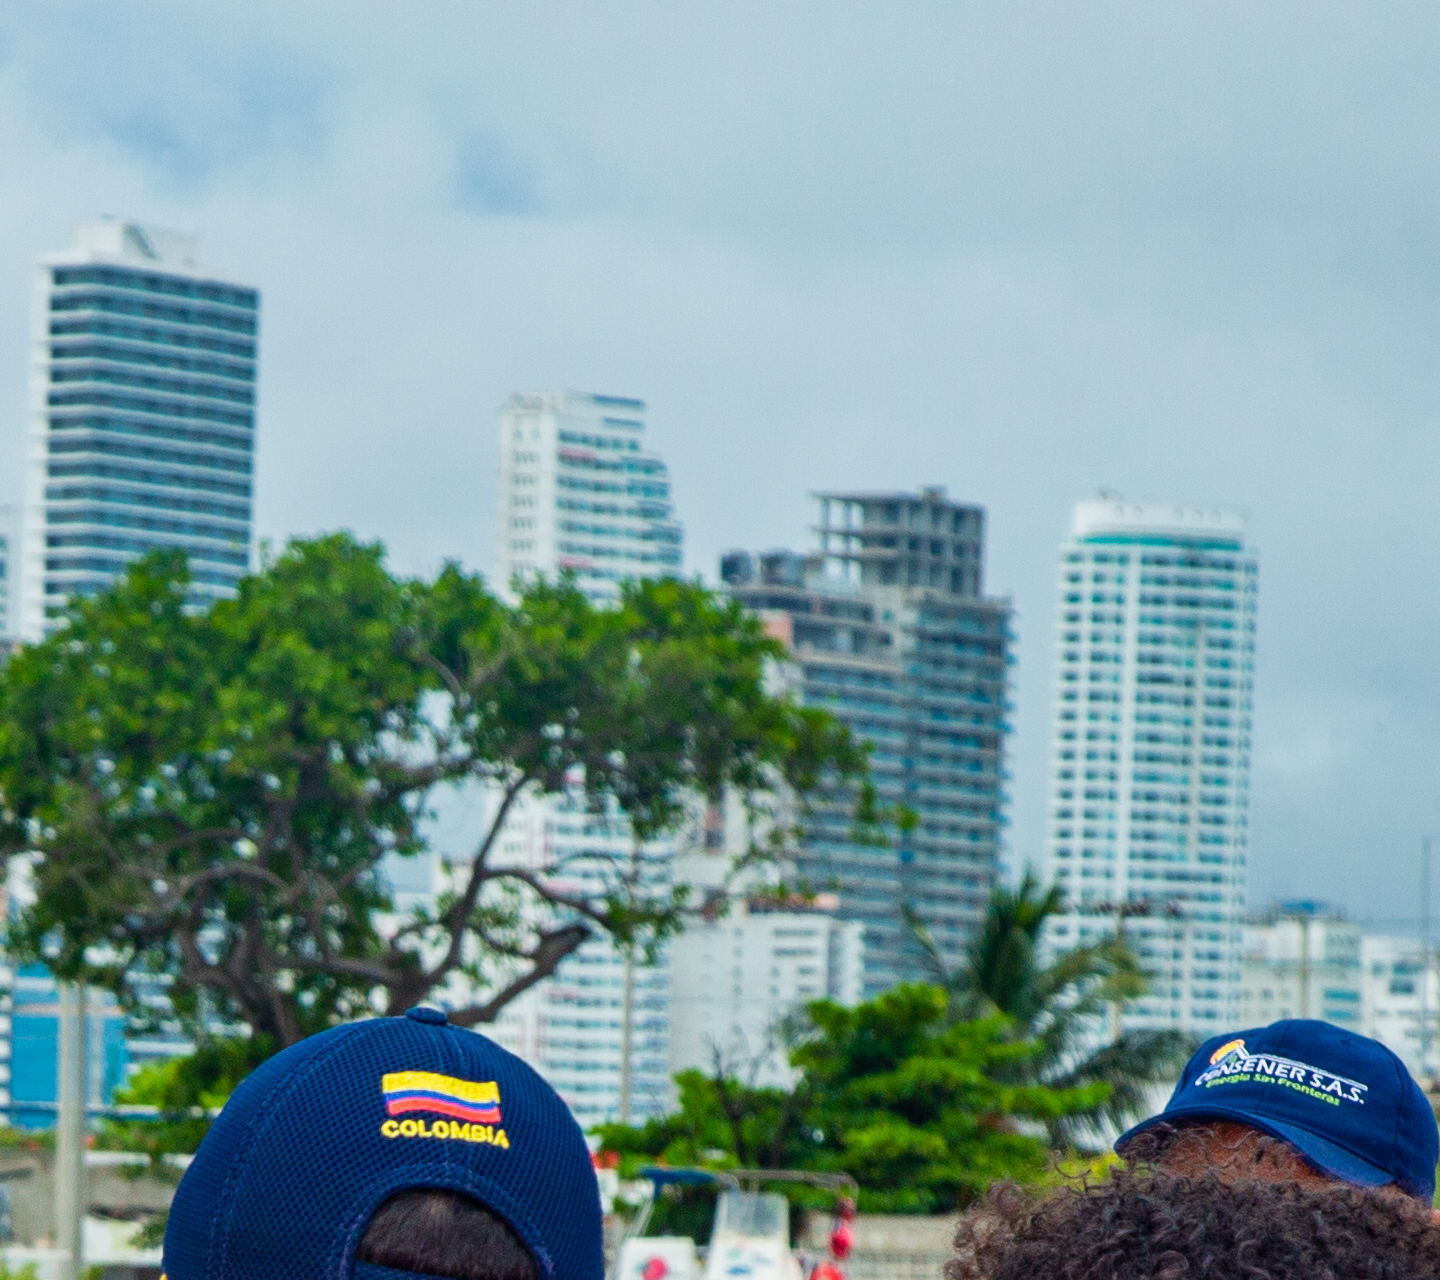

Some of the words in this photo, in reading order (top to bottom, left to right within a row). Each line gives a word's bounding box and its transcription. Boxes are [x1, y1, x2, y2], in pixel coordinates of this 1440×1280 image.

[1195, 1056, 1306, 1087] CONSENER
[1309, 1072, 1365, 1105] S.A.S.
[1252, 1073, 1276, 1084] Sin
[380, 1119, 511, 1150] COLOMBIA
